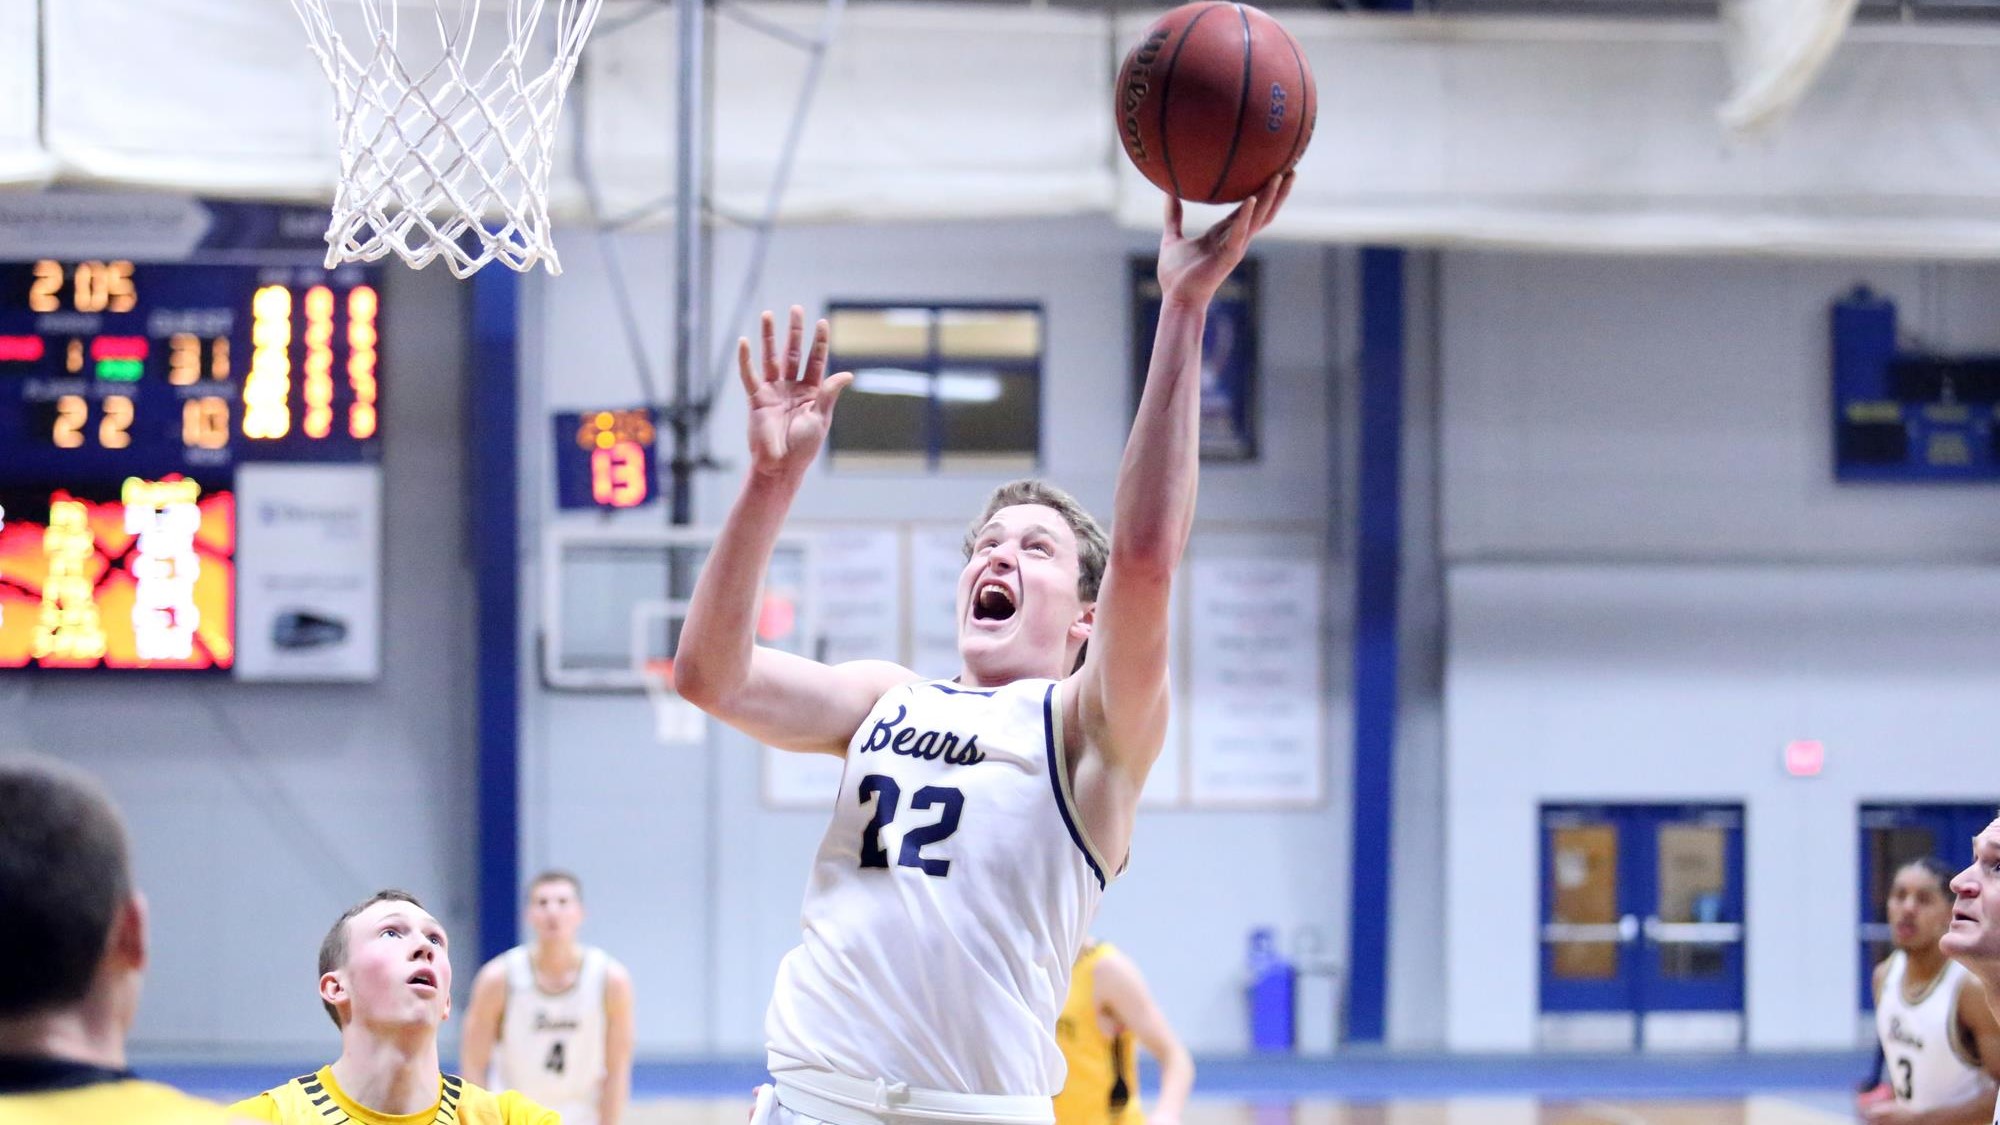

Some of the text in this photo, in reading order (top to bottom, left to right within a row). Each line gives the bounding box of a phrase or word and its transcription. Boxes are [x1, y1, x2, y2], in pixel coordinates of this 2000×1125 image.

[1265, 81, 1288, 133] CSP
[591, 441, 648, 508] 13
[860, 704, 986, 766] Bears
[858, 774, 965, 877] 22
[545, 1039, 565, 1074] 4
[1898, 1058, 1912, 1100] 3
